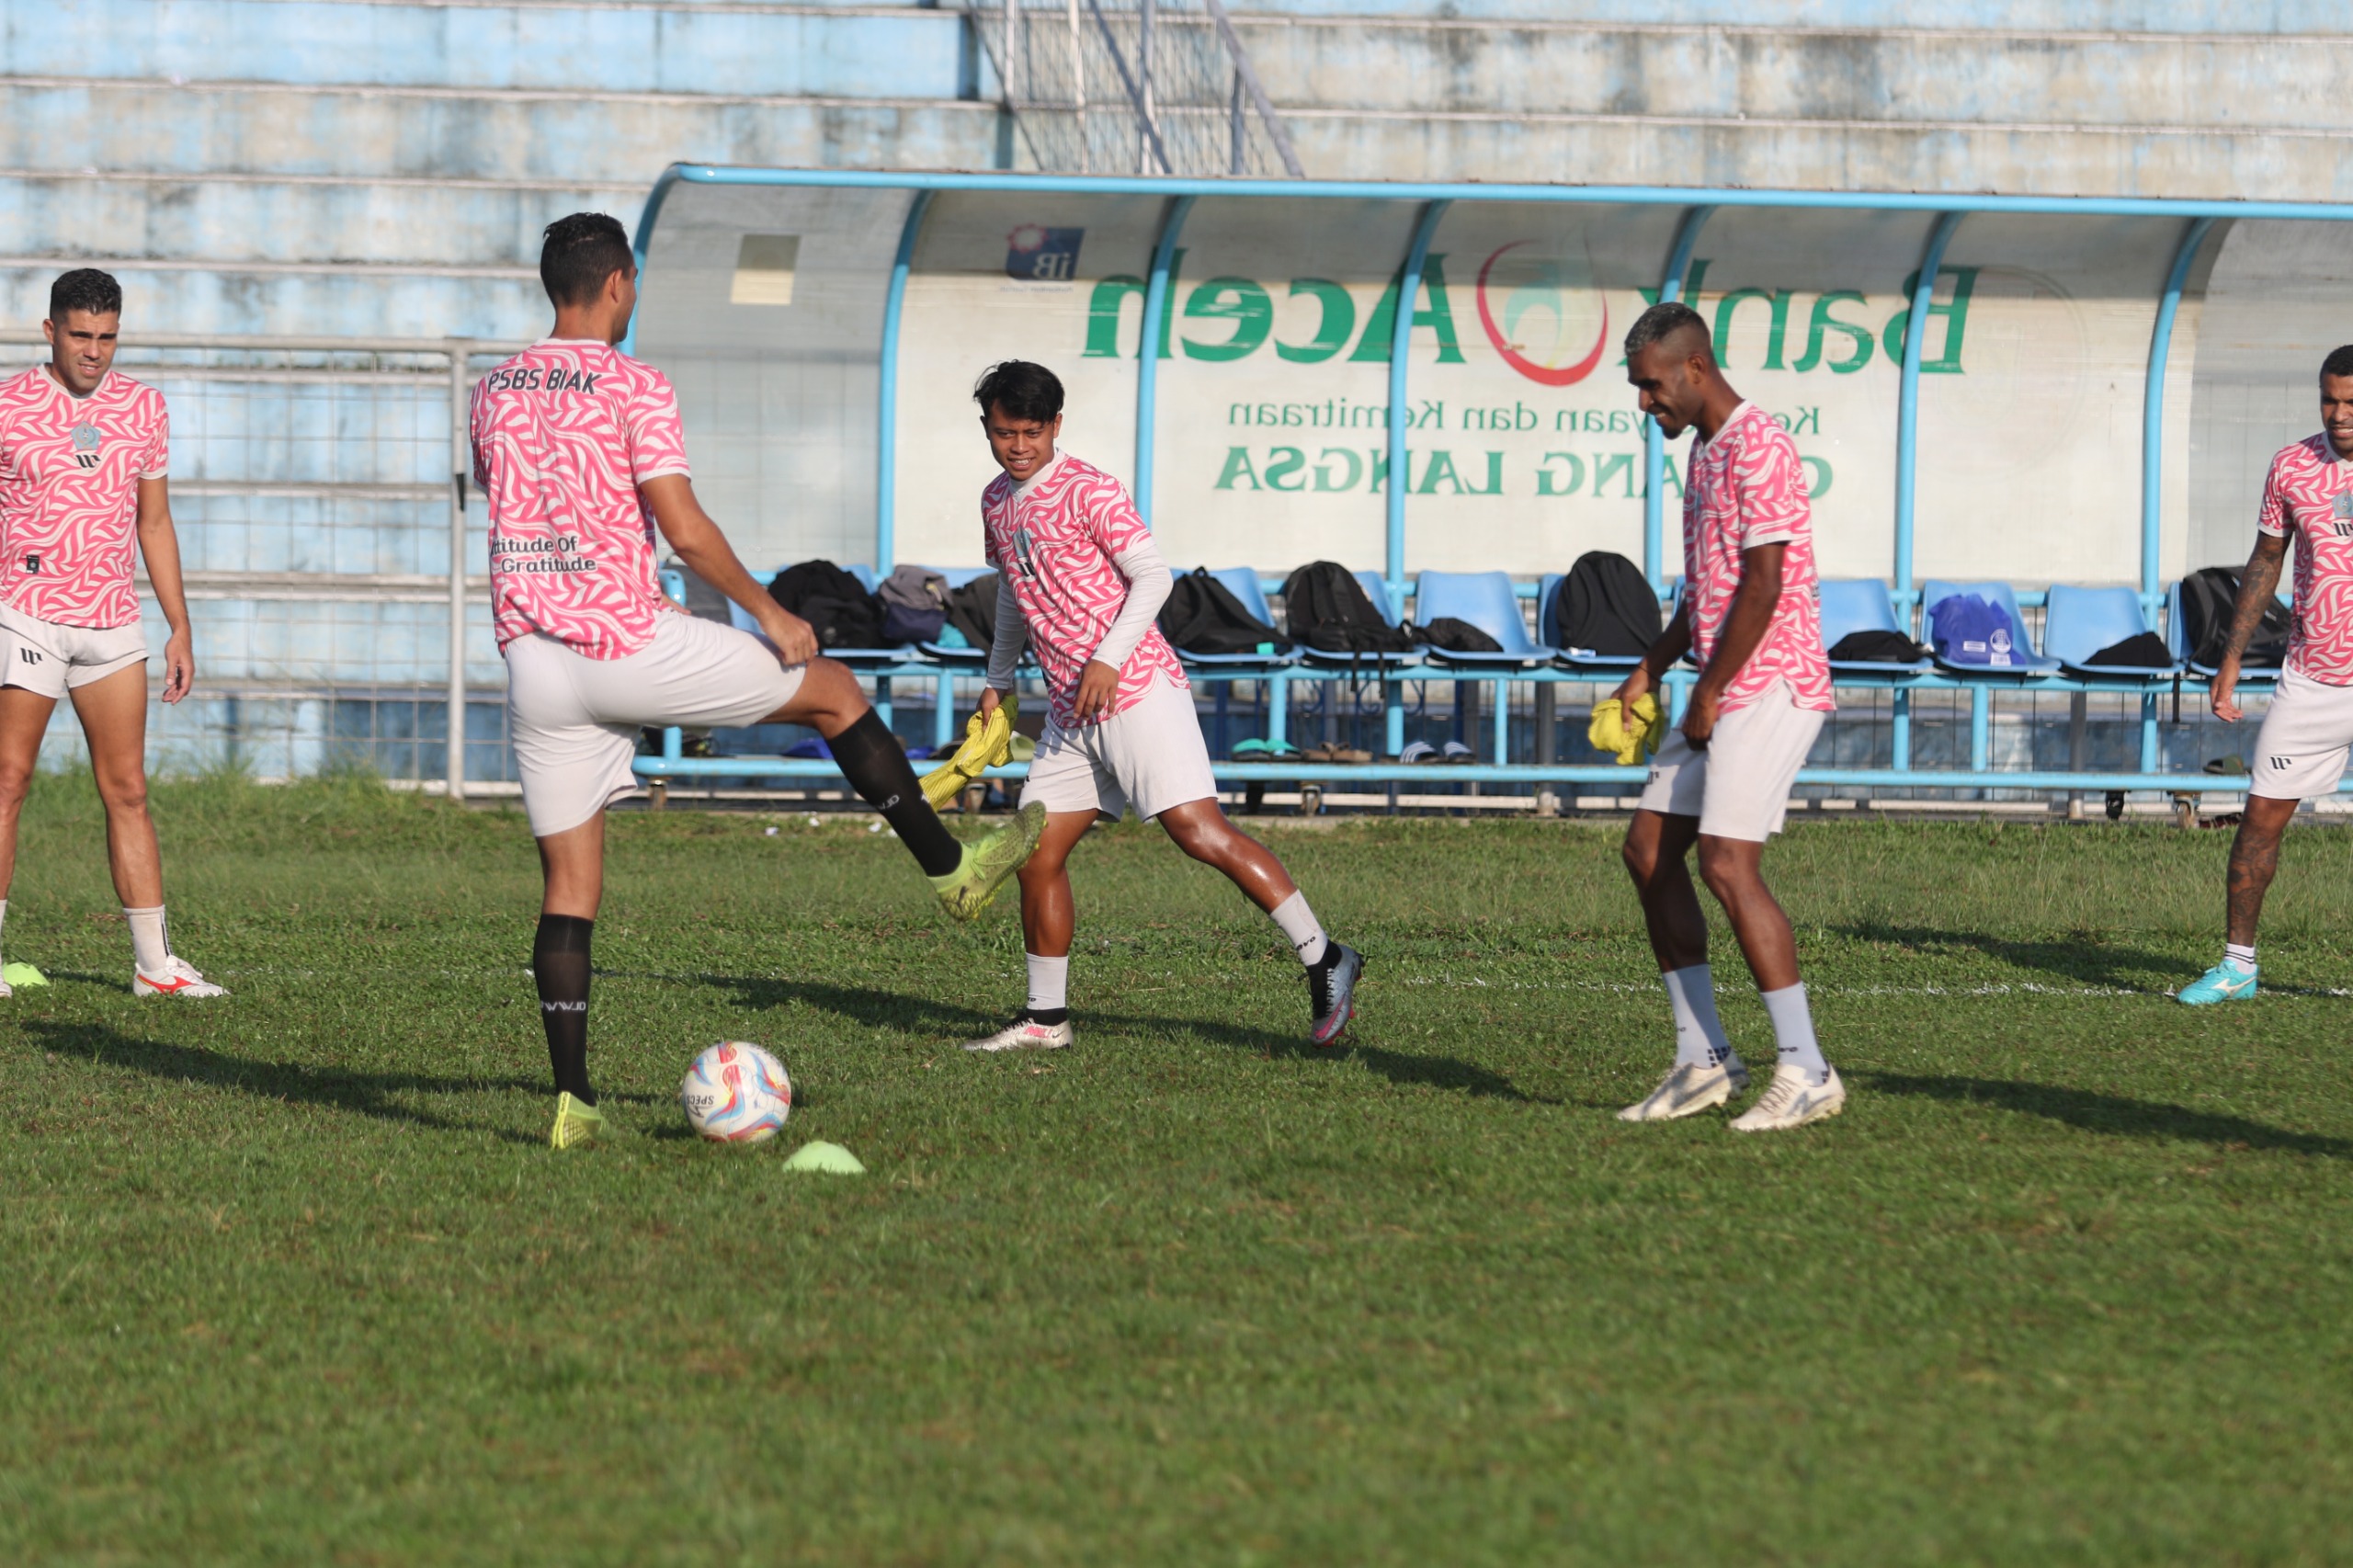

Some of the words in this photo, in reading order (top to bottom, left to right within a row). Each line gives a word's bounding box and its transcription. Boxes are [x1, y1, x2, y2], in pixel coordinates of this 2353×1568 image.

[487, 368, 544, 395] PSBS
[546, 368, 602, 395] BIAK
[557, 536, 578, 552] Of
[501, 556, 597, 574] Gratitude
